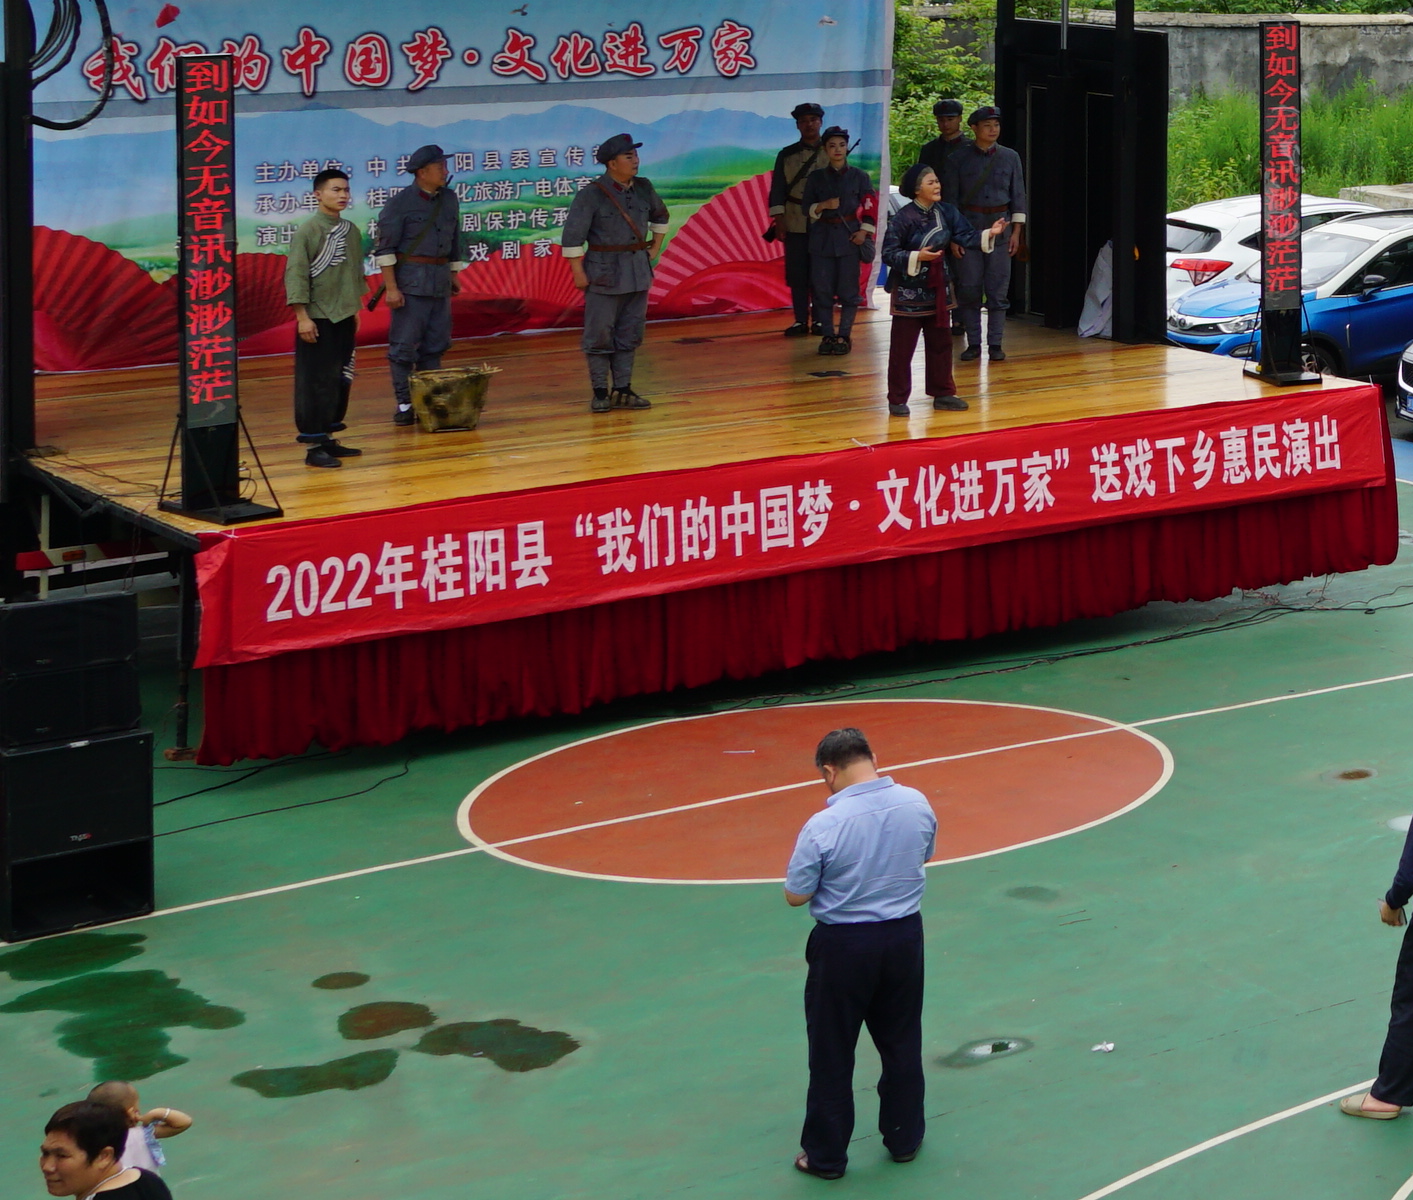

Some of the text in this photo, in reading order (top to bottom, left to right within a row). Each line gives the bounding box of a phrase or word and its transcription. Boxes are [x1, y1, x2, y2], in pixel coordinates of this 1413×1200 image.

[184, 59, 233, 405] 到如今无音讯渺渺茫茫
[1264, 25, 1299, 292] 到如今无音讯渺渺茫茫
[266, 519, 553, 623] 2022年桂阳县
[1090, 415, 1342, 504] 送戏下乡惠民演出
